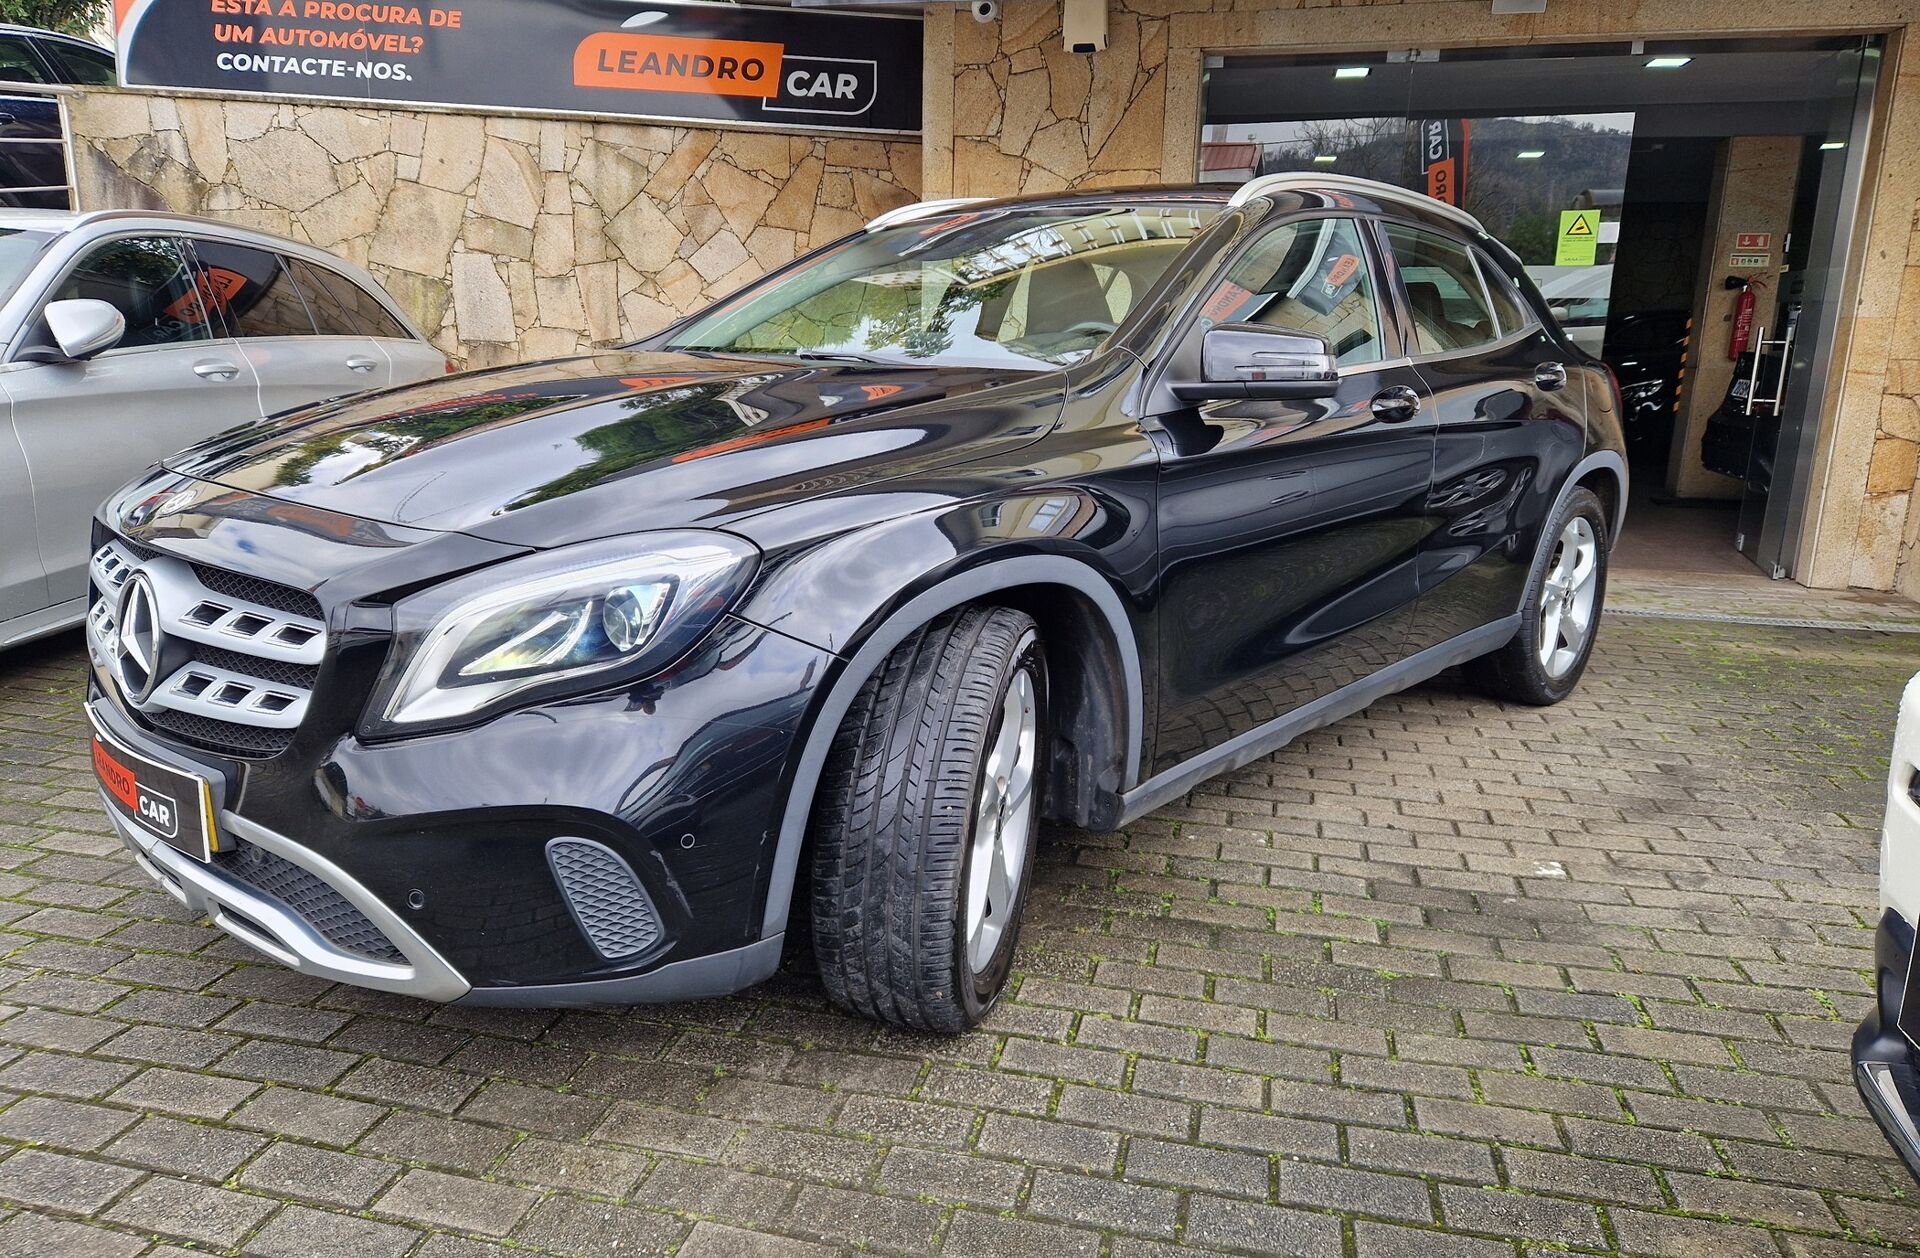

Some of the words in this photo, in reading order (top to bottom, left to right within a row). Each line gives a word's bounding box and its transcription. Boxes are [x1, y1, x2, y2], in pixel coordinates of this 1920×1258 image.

[303, 1, 422, 25] PROCURA
[428, 10, 461, 28] DE
[214, 24, 253, 43] UM
[259, 27, 424, 54] AUTOMÓVEL?
[216, 52, 412, 81] CONTACTE-NOS.
[597, 48, 765, 81] LEANDRO
[786, 70, 858, 99] CAR
[139, 796, 170, 827] CAR
